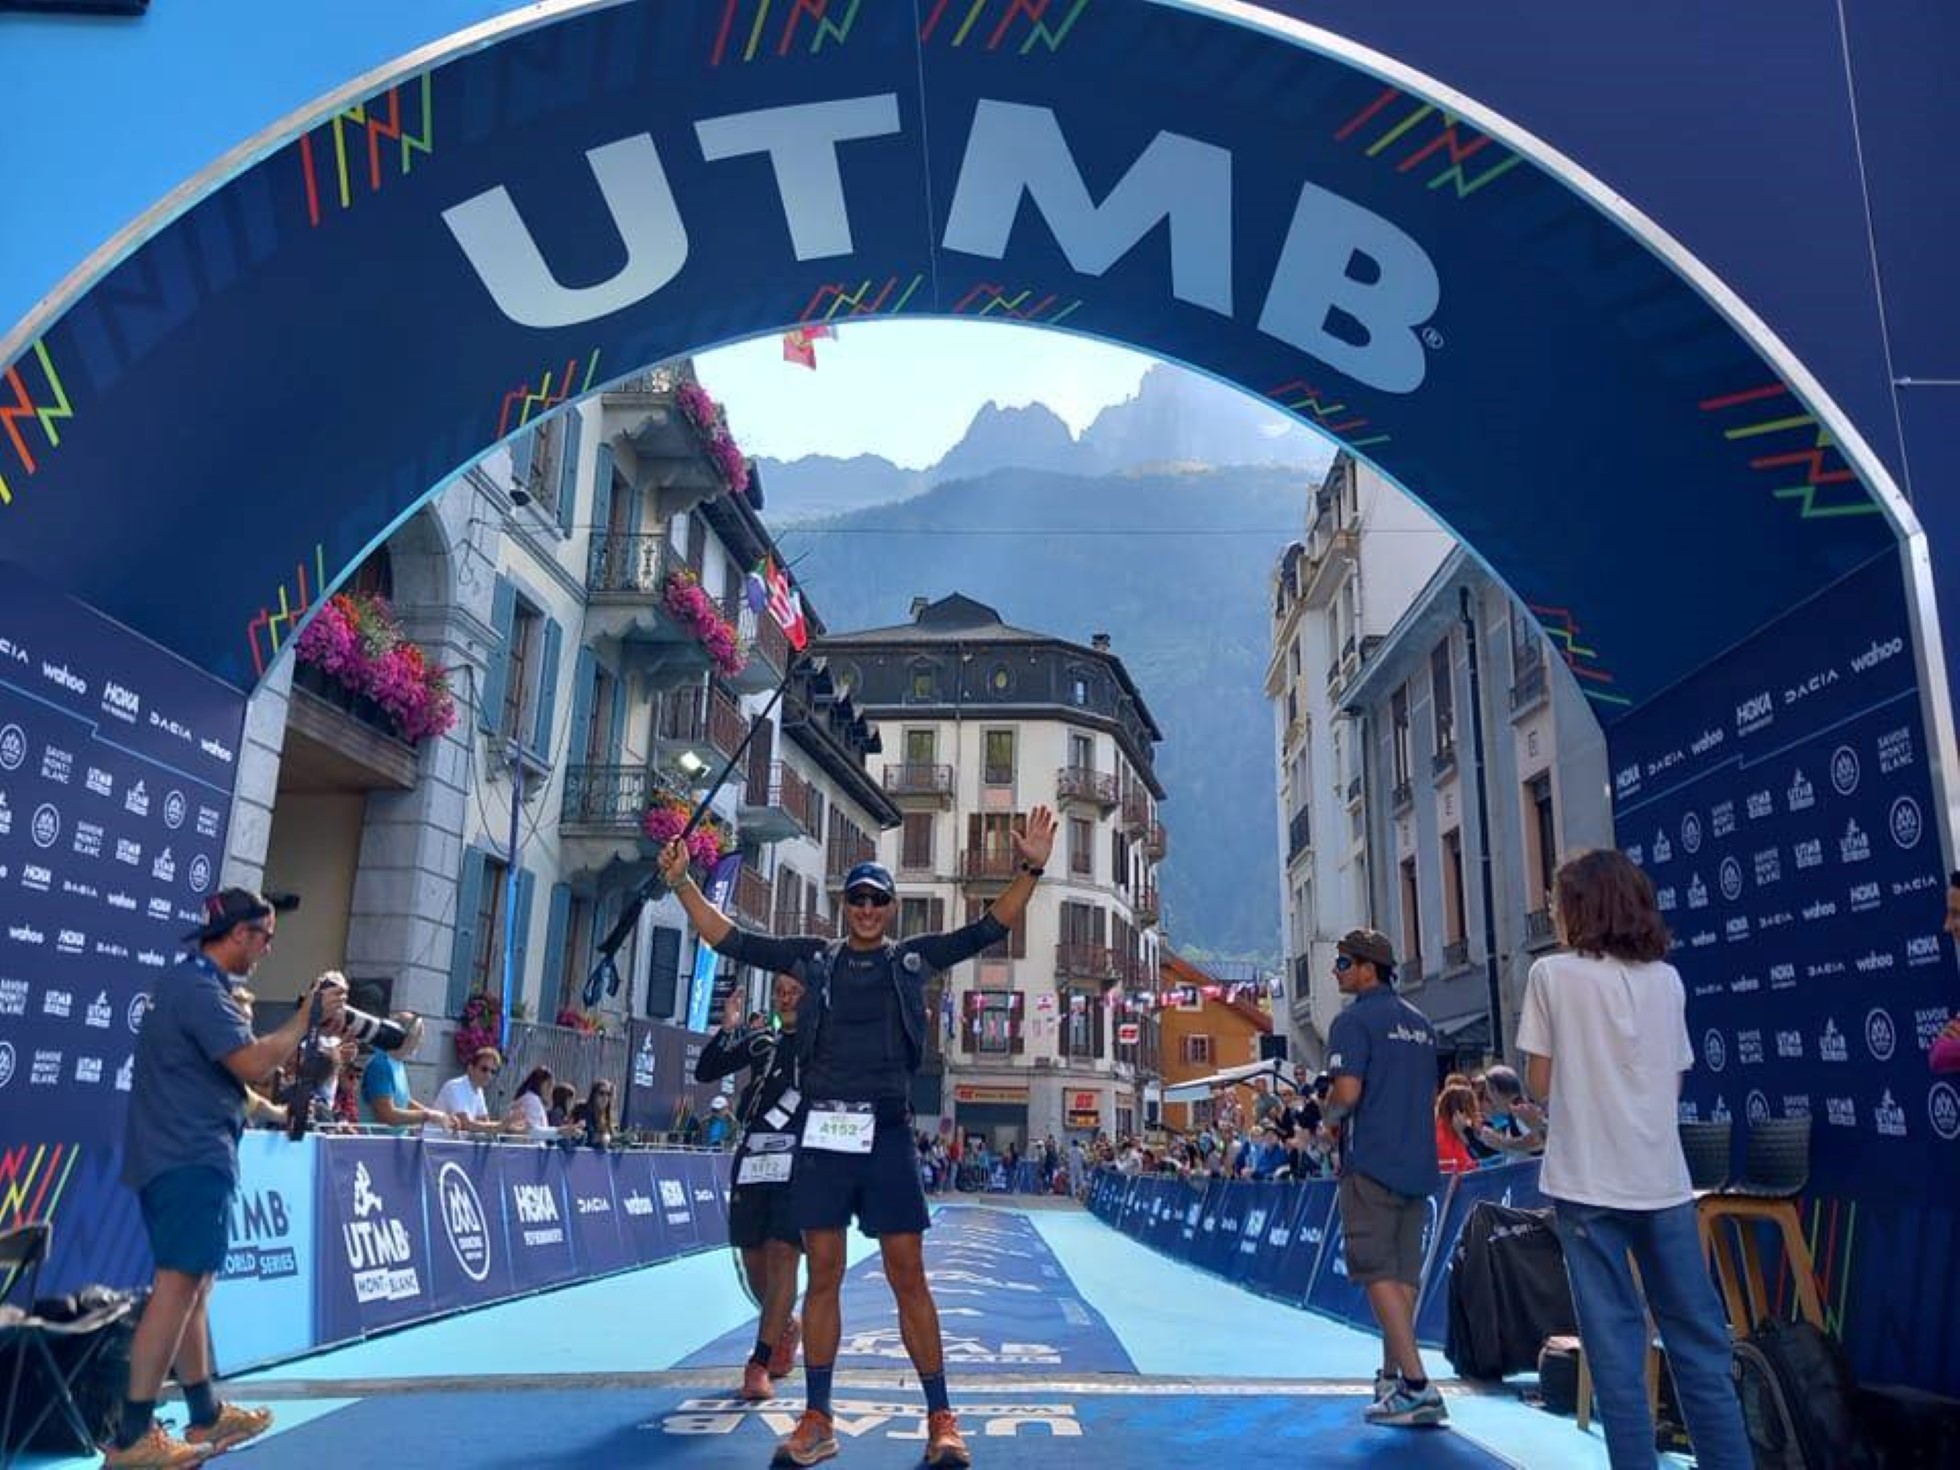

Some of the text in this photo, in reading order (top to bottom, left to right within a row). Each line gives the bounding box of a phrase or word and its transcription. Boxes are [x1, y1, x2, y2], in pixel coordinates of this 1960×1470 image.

[441, 92, 1441, 394] UTMB
[42, 660, 87, 694] wahoo
[104, 681, 139, 714] HOKA
[1648, 750, 1685, 776] DACIA
[1691, 728, 1724, 755] wahoo
[1736, 691, 1772, 726] HOKA
[1785, 668, 1840, 704] DACIA
[1850, 637, 1903, 673] wahoo
[1802, 899, 1836, 920] wahoo
[1851, 881, 1880, 904] HOKA
[1892, 875, 1937, 894] DACIA
[1856, 950, 1893, 972] wahoo
[1907, 934, 1940, 957] HOKA
[224, 1190, 290, 1241] TMB
[218, 1252, 256, 1274] ORLD
[342, 1217, 411, 1269] UTMB
